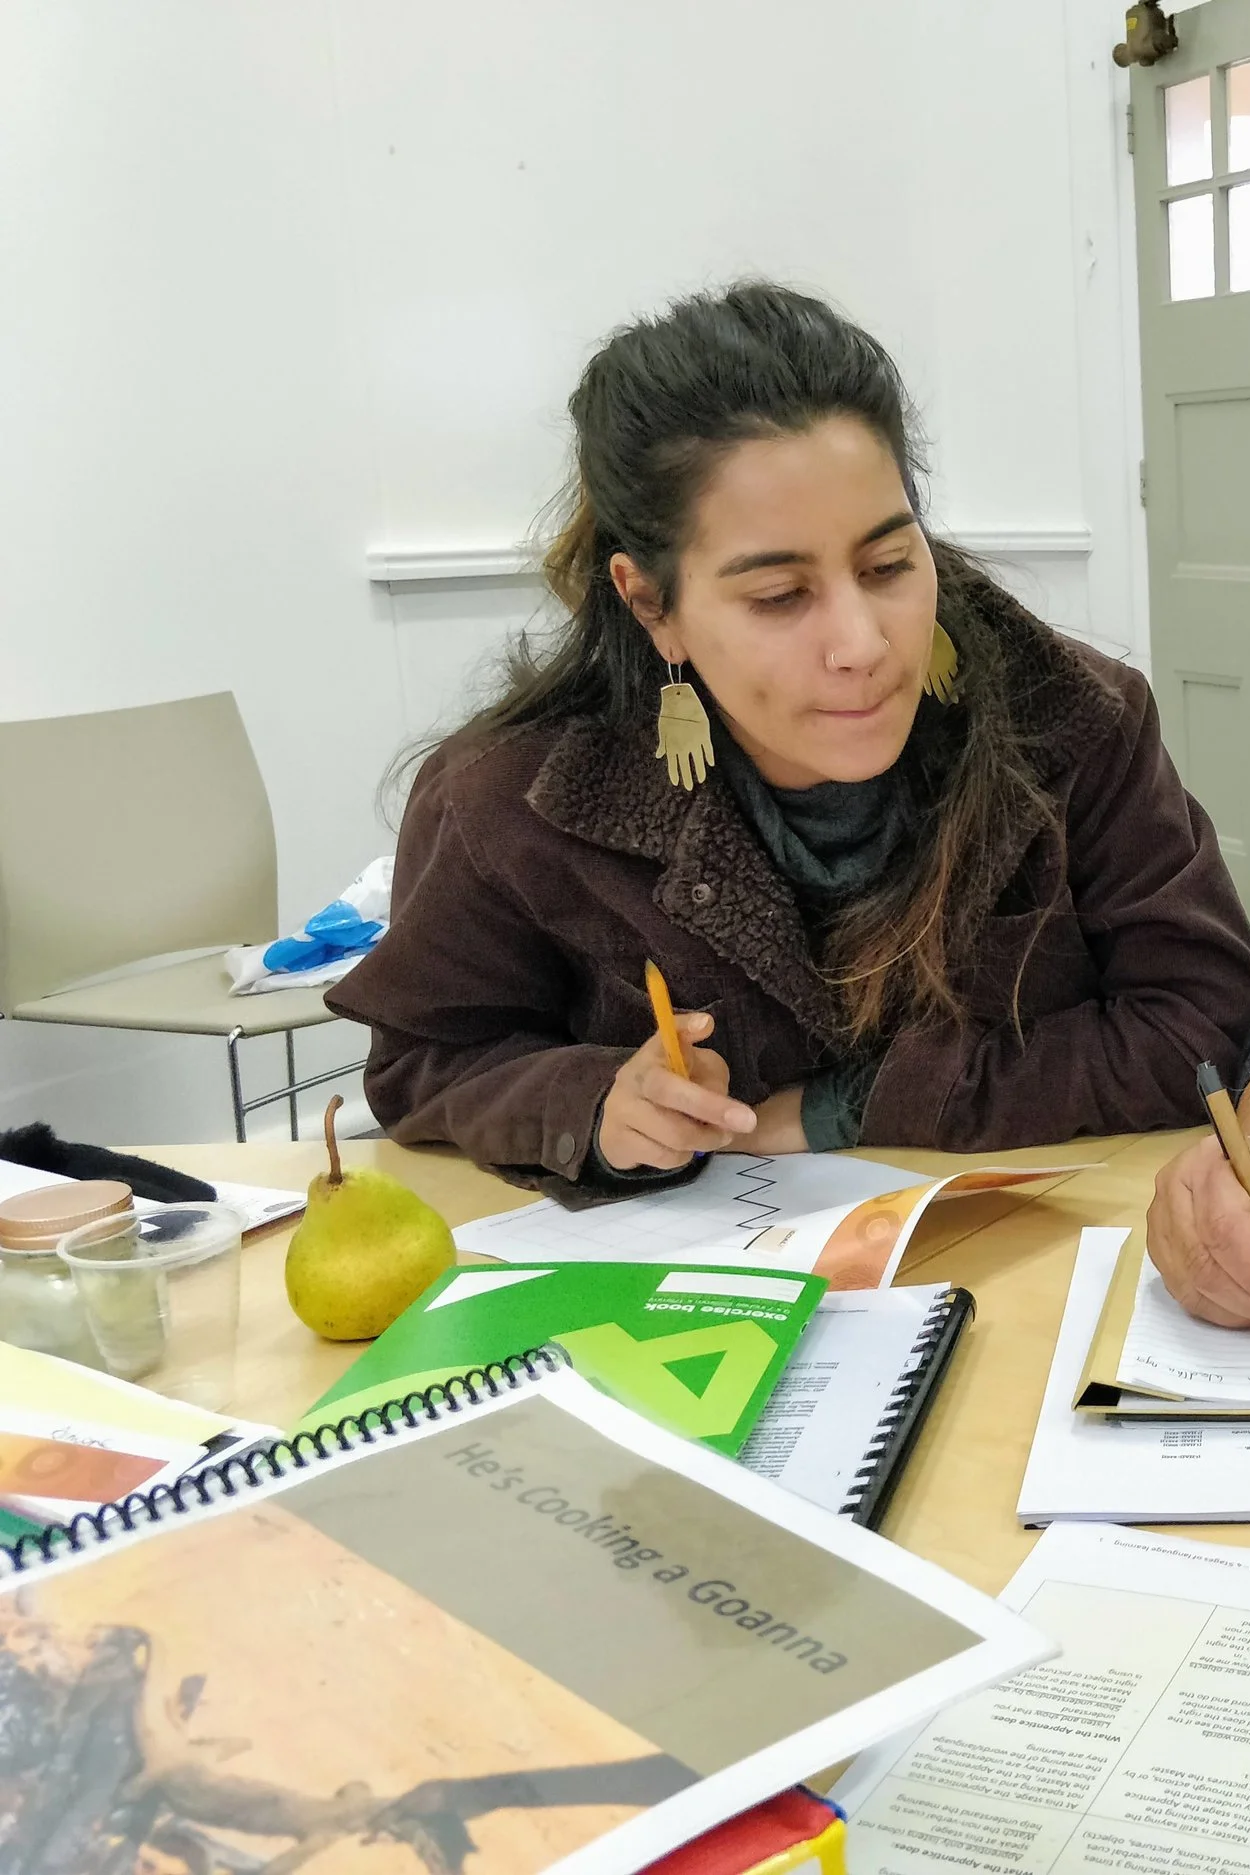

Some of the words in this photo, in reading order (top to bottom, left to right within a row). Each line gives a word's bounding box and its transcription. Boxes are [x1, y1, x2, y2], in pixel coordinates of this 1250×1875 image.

[643, 1302, 696, 1313] book
[700, 1305, 788, 1322] exercise
[1113, 1539, 1149, 1552] learning
[443, 1441, 525, 1493] He's
[516, 1484, 665, 1571] Cooking
[652, 1563, 691, 1585] a
[687, 1578, 850, 1676] Goanna
[1150, 1546, 1191, 1559] language
